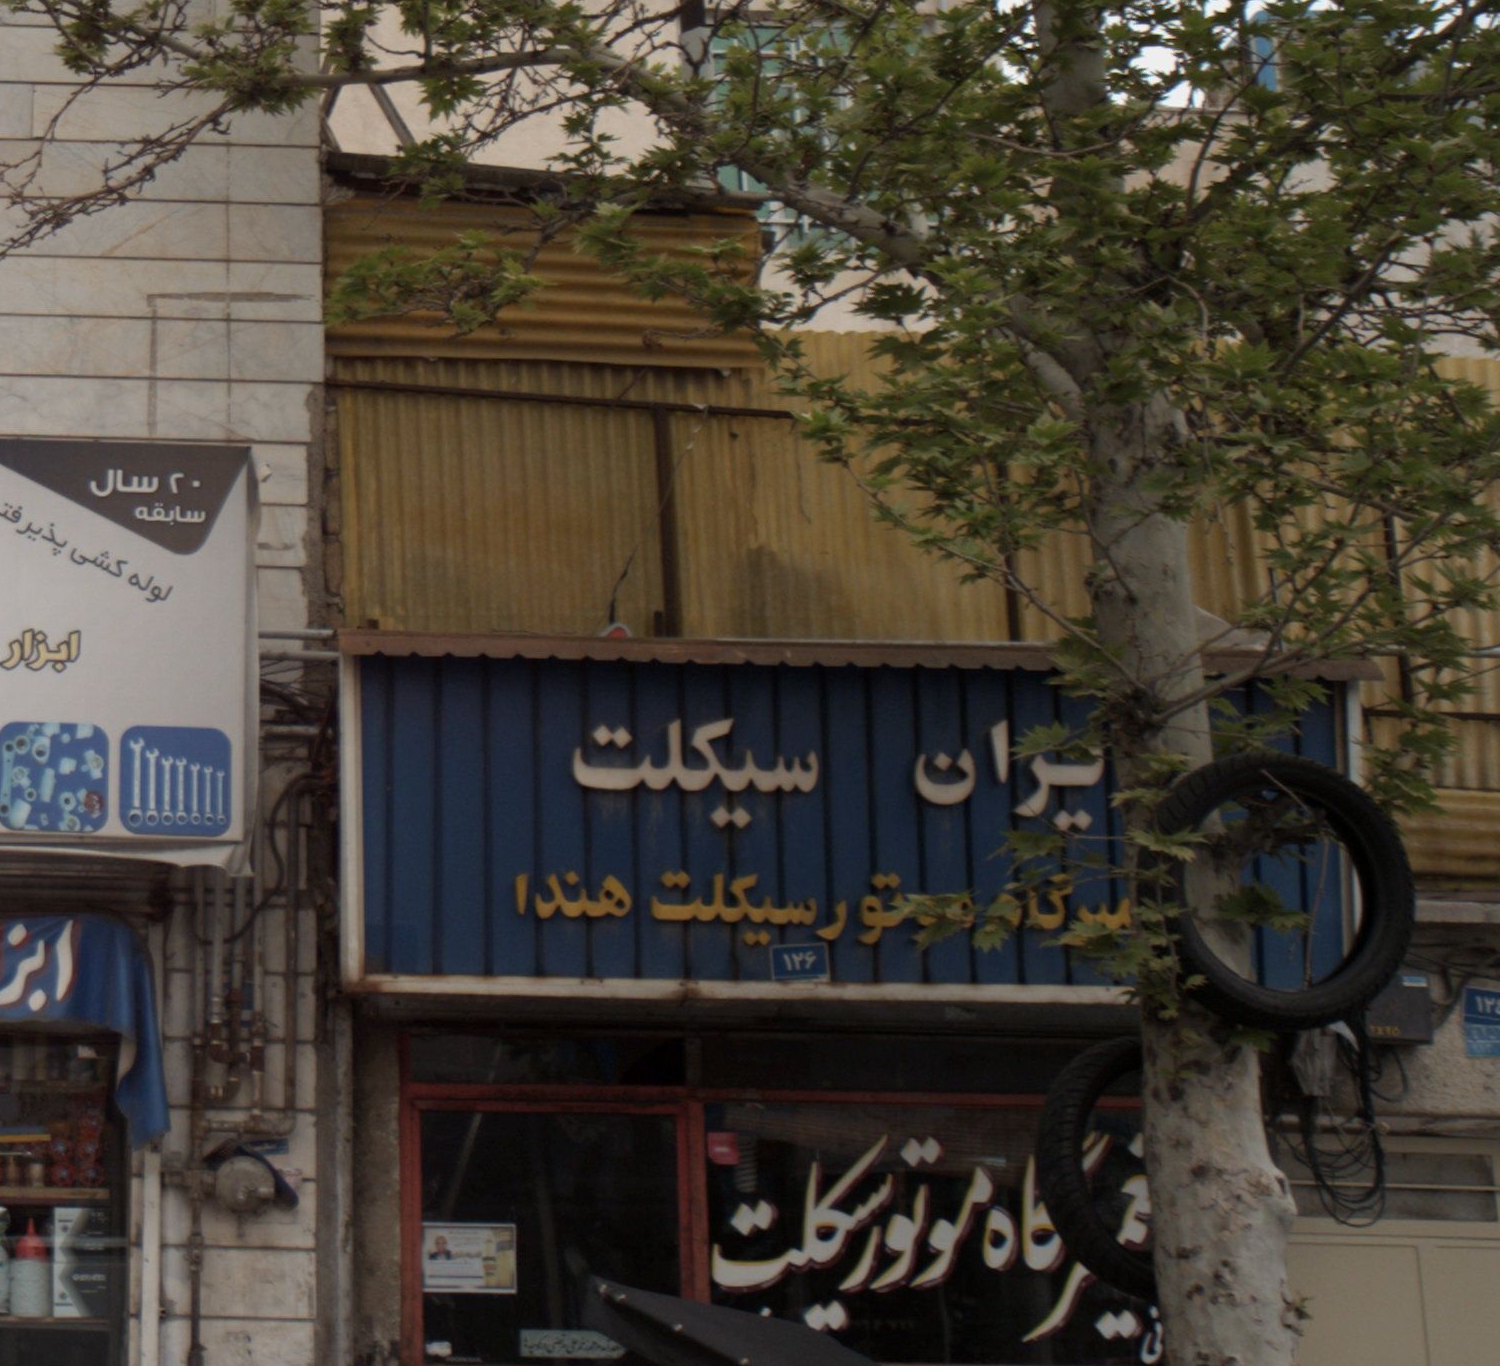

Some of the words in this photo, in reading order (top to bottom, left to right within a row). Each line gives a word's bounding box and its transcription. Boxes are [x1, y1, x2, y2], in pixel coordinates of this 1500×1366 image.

[90, 469, 158, 497] سال
[135, 501, 206, 525] سابقه
[70, 546, 128, 578] کشی
[128, 575, 173, 603] لوله
[3, 631, 81, 671] ابزار
[573, 718, 820, 829] سیکلت
[913, 718, 1106, 831] یران
[514, 870, 632, 920] هندا
